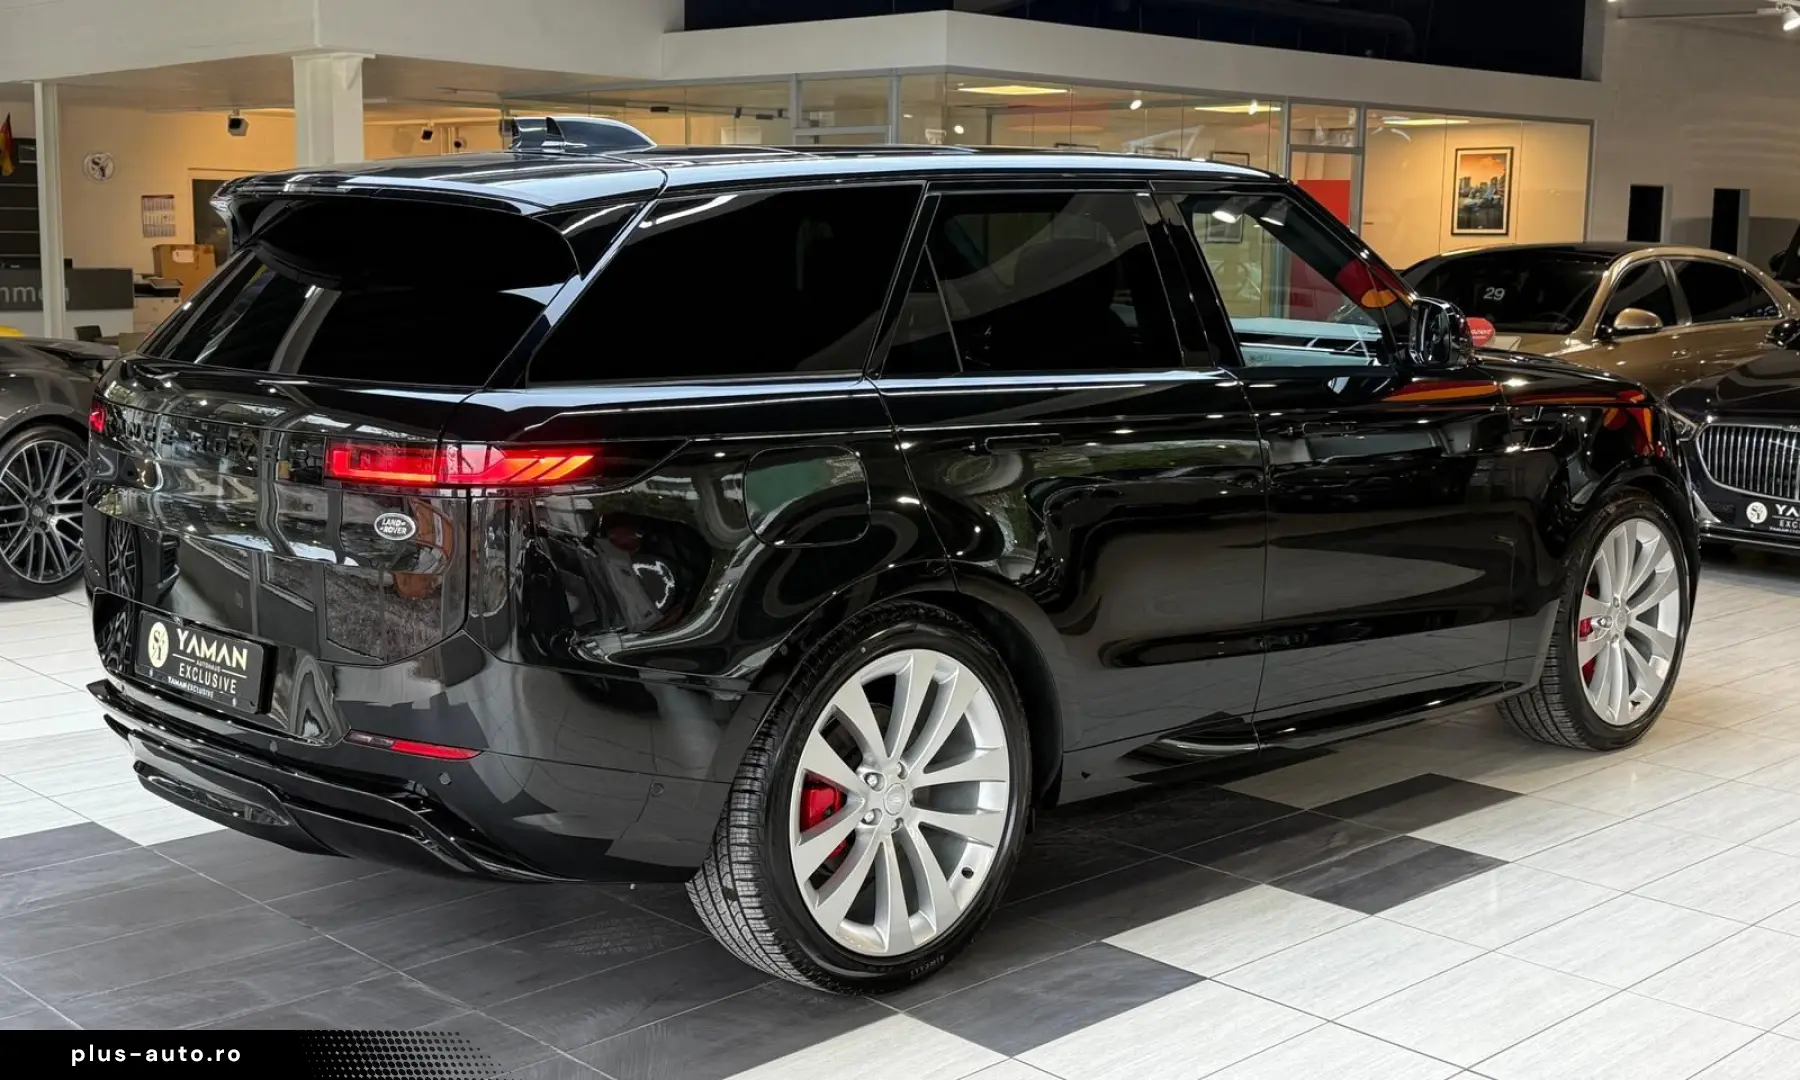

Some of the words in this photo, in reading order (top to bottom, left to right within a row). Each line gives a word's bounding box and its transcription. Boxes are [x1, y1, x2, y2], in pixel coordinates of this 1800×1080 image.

[1483, 286, 1505, 300] 29
[382, 517, 402, 526] LAND
[383, 526, 407, 534] ROVER
[176, 628, 248, 671] YAMAN
[179, 662, 237, 694] EXCLUSIVE
